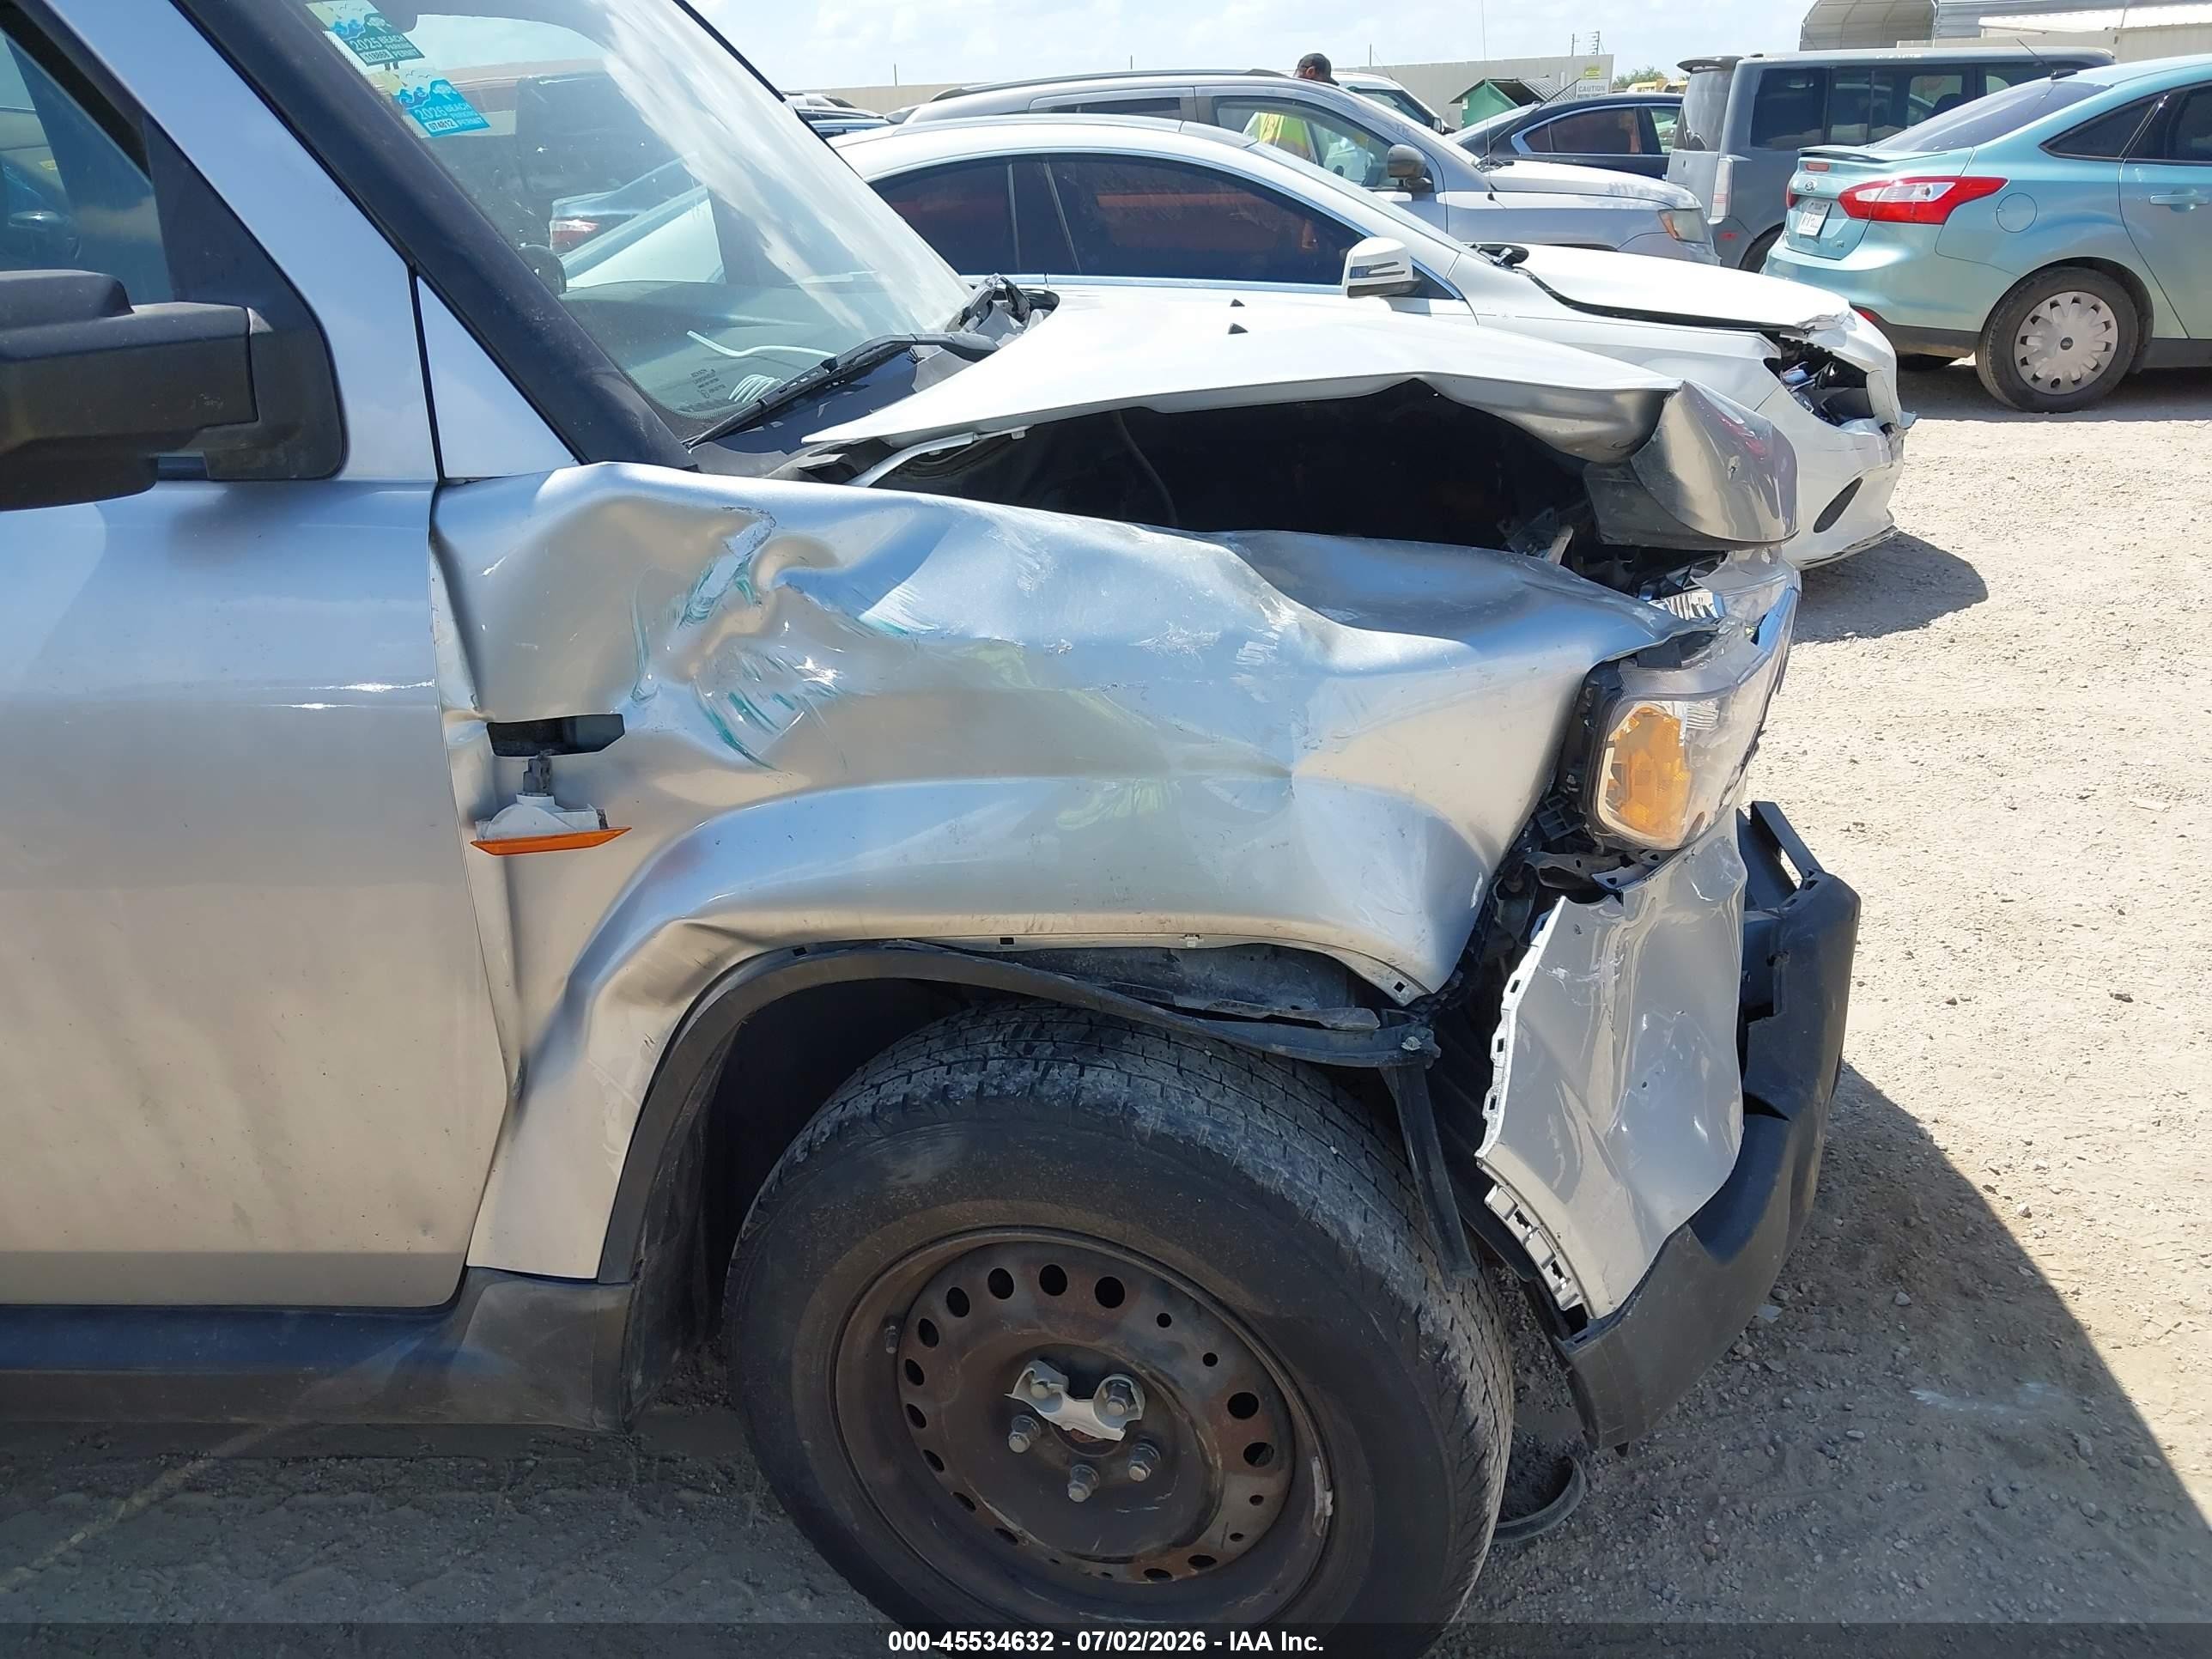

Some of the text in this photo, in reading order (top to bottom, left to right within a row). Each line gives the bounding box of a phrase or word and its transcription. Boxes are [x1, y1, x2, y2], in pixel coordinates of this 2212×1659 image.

[349, 34, 407, 52] 2025 BEACH
[414, 102, 472, 119] 2026 BEACH
